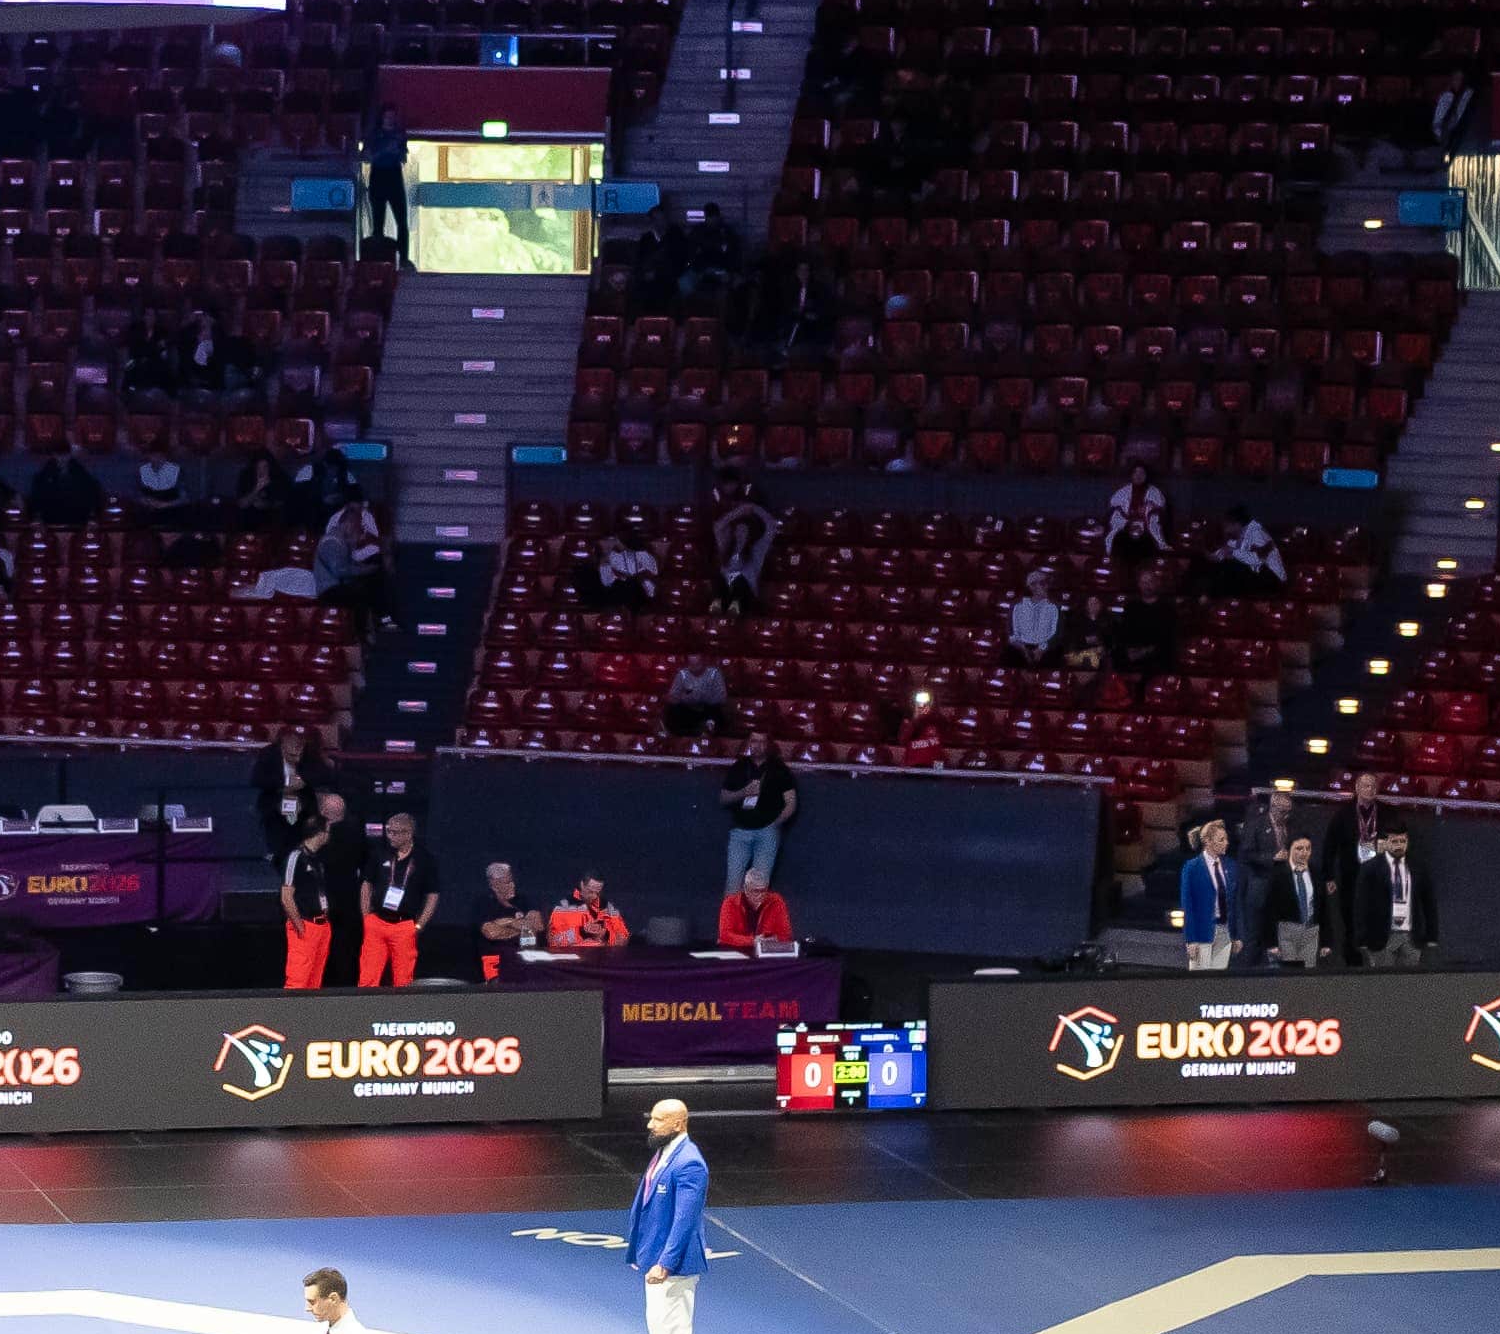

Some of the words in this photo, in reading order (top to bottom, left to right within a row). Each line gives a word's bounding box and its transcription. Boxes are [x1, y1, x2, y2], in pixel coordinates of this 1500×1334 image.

[604, 190, 619, 211] R
[1441, 200, 1456, 220] R
[27, 875, 88, 894] EURO
[622, 1002, 722, 1022] MEDICAL
[723, 1000, 799, 1020] TEAM
[1200, 1004, 1278, 1018] TAEKWONDO
[372, 1021, 455, 1036] TAEKWONDO
[1137, 1021, 1244, 1059] EURO
[1248, 1019, 1341, 1057] 2026
[307, 1040, 420, 1078] EURO
[423, 1037, 521, 1075] 2026
[804, 1062, 822, 1088] 0
[881, 1060, 898, 1086] 0
[1181, 1063, 1243, 1077] GERMANY
[1246, 1061, 1296, 1075] MUNICH
[354, 1082, 418, 1097] GERMANY
[422, 1081, 474, 1095] MUNICH
